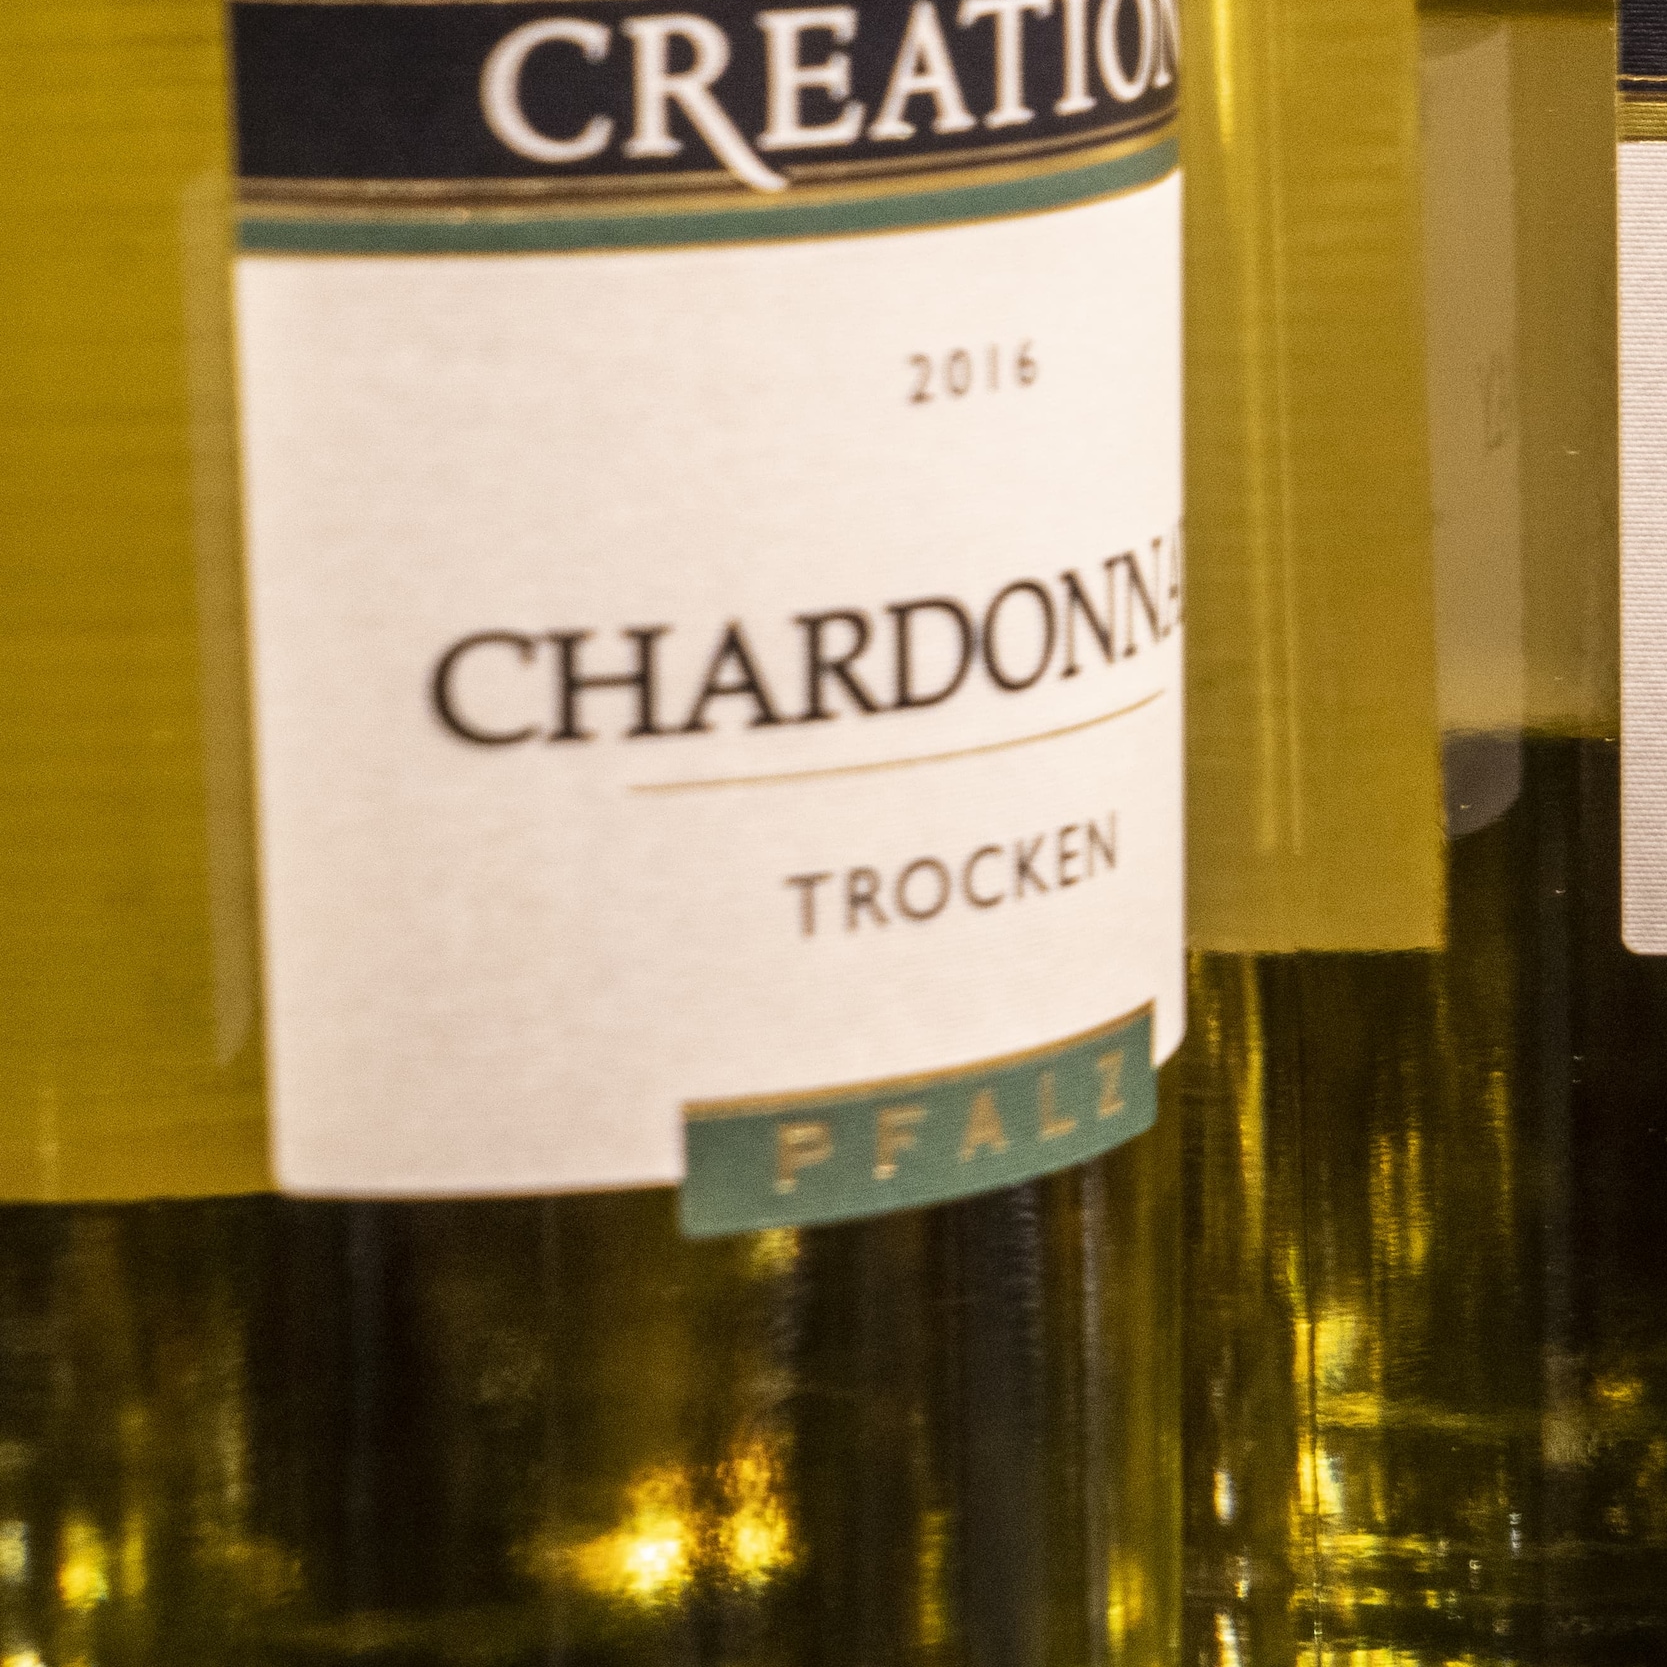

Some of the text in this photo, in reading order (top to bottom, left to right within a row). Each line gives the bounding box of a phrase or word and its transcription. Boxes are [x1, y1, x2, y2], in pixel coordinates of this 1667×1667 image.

[905, 340, 1038, 406] 2016
[430, 522, 1182, 748] CHARDONNA
[784, 810, 1118, 936] TROCKEN
[774, 1050, 1125, 1194] PFALZ
